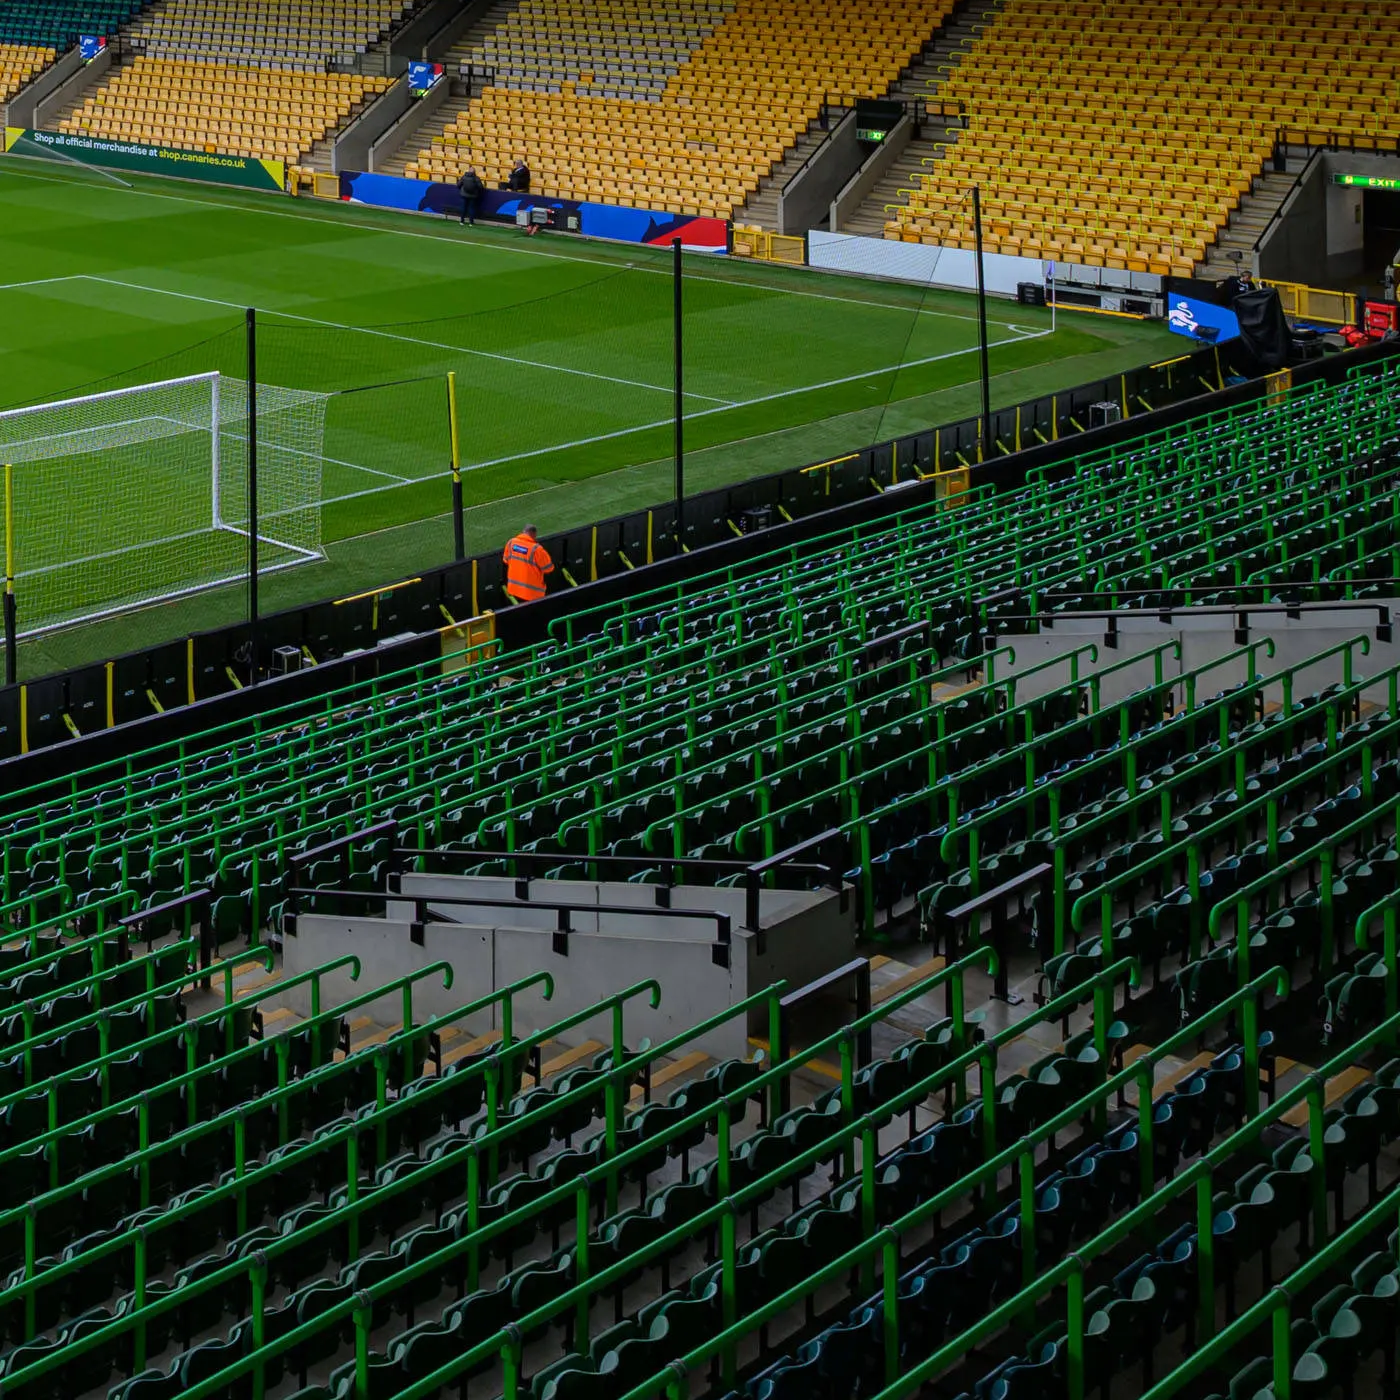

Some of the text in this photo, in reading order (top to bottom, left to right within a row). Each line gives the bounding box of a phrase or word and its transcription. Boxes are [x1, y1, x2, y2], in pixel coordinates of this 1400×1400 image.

[34, 132, 246, 168] Shop all official merchandise at shop.canaries.co.uk
[1368, 177, 1397, 188] EXIT
